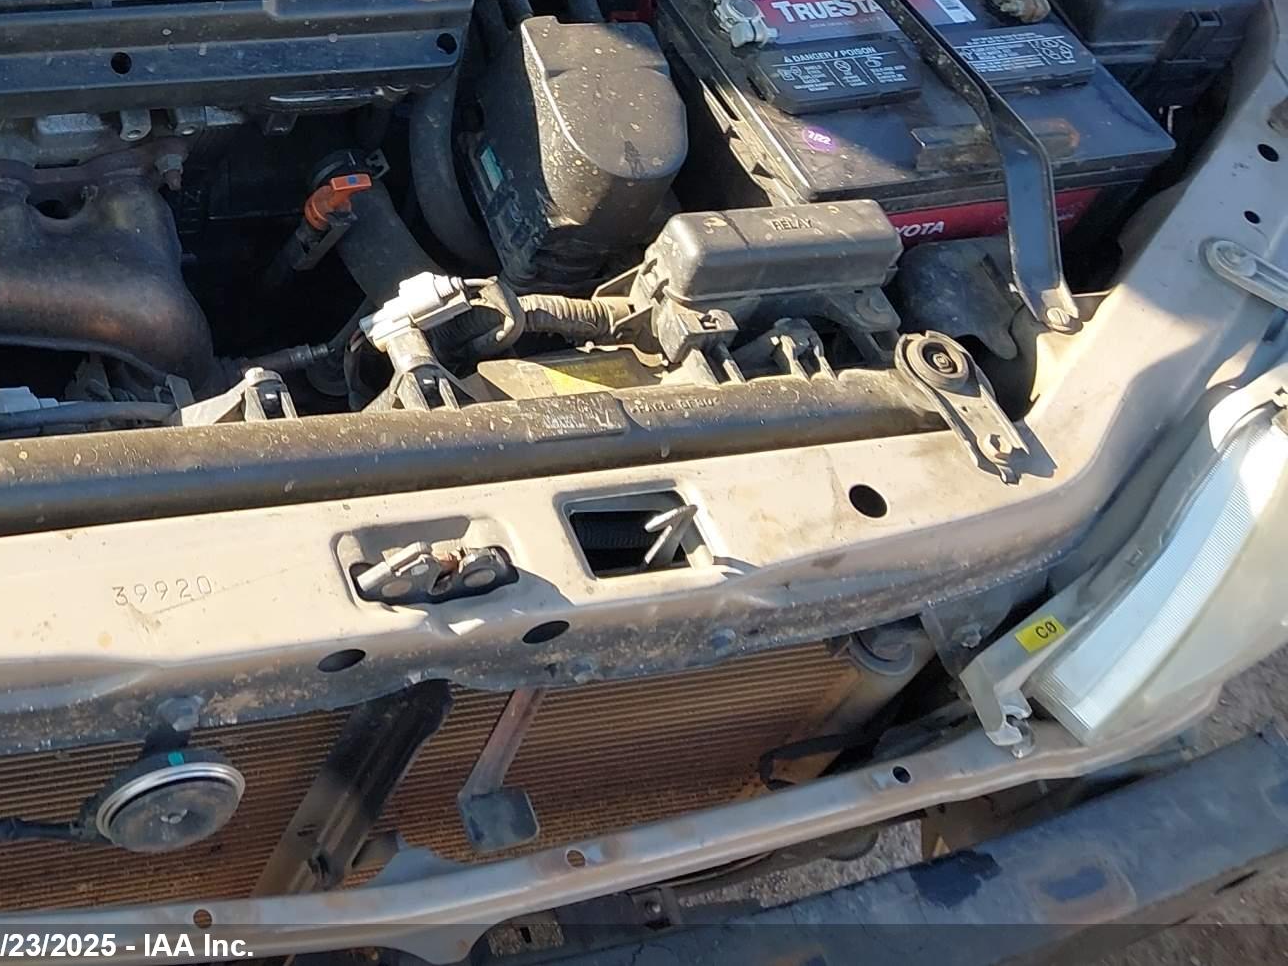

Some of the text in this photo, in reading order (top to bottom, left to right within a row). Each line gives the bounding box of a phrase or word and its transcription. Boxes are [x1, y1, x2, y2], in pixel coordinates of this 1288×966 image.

[792, 51, 833, 62] DANGER
[841, 46, 877, 57] POISON
[771, 217, 814, 231] RELAY
[112, 575, 212, 606] 39920
